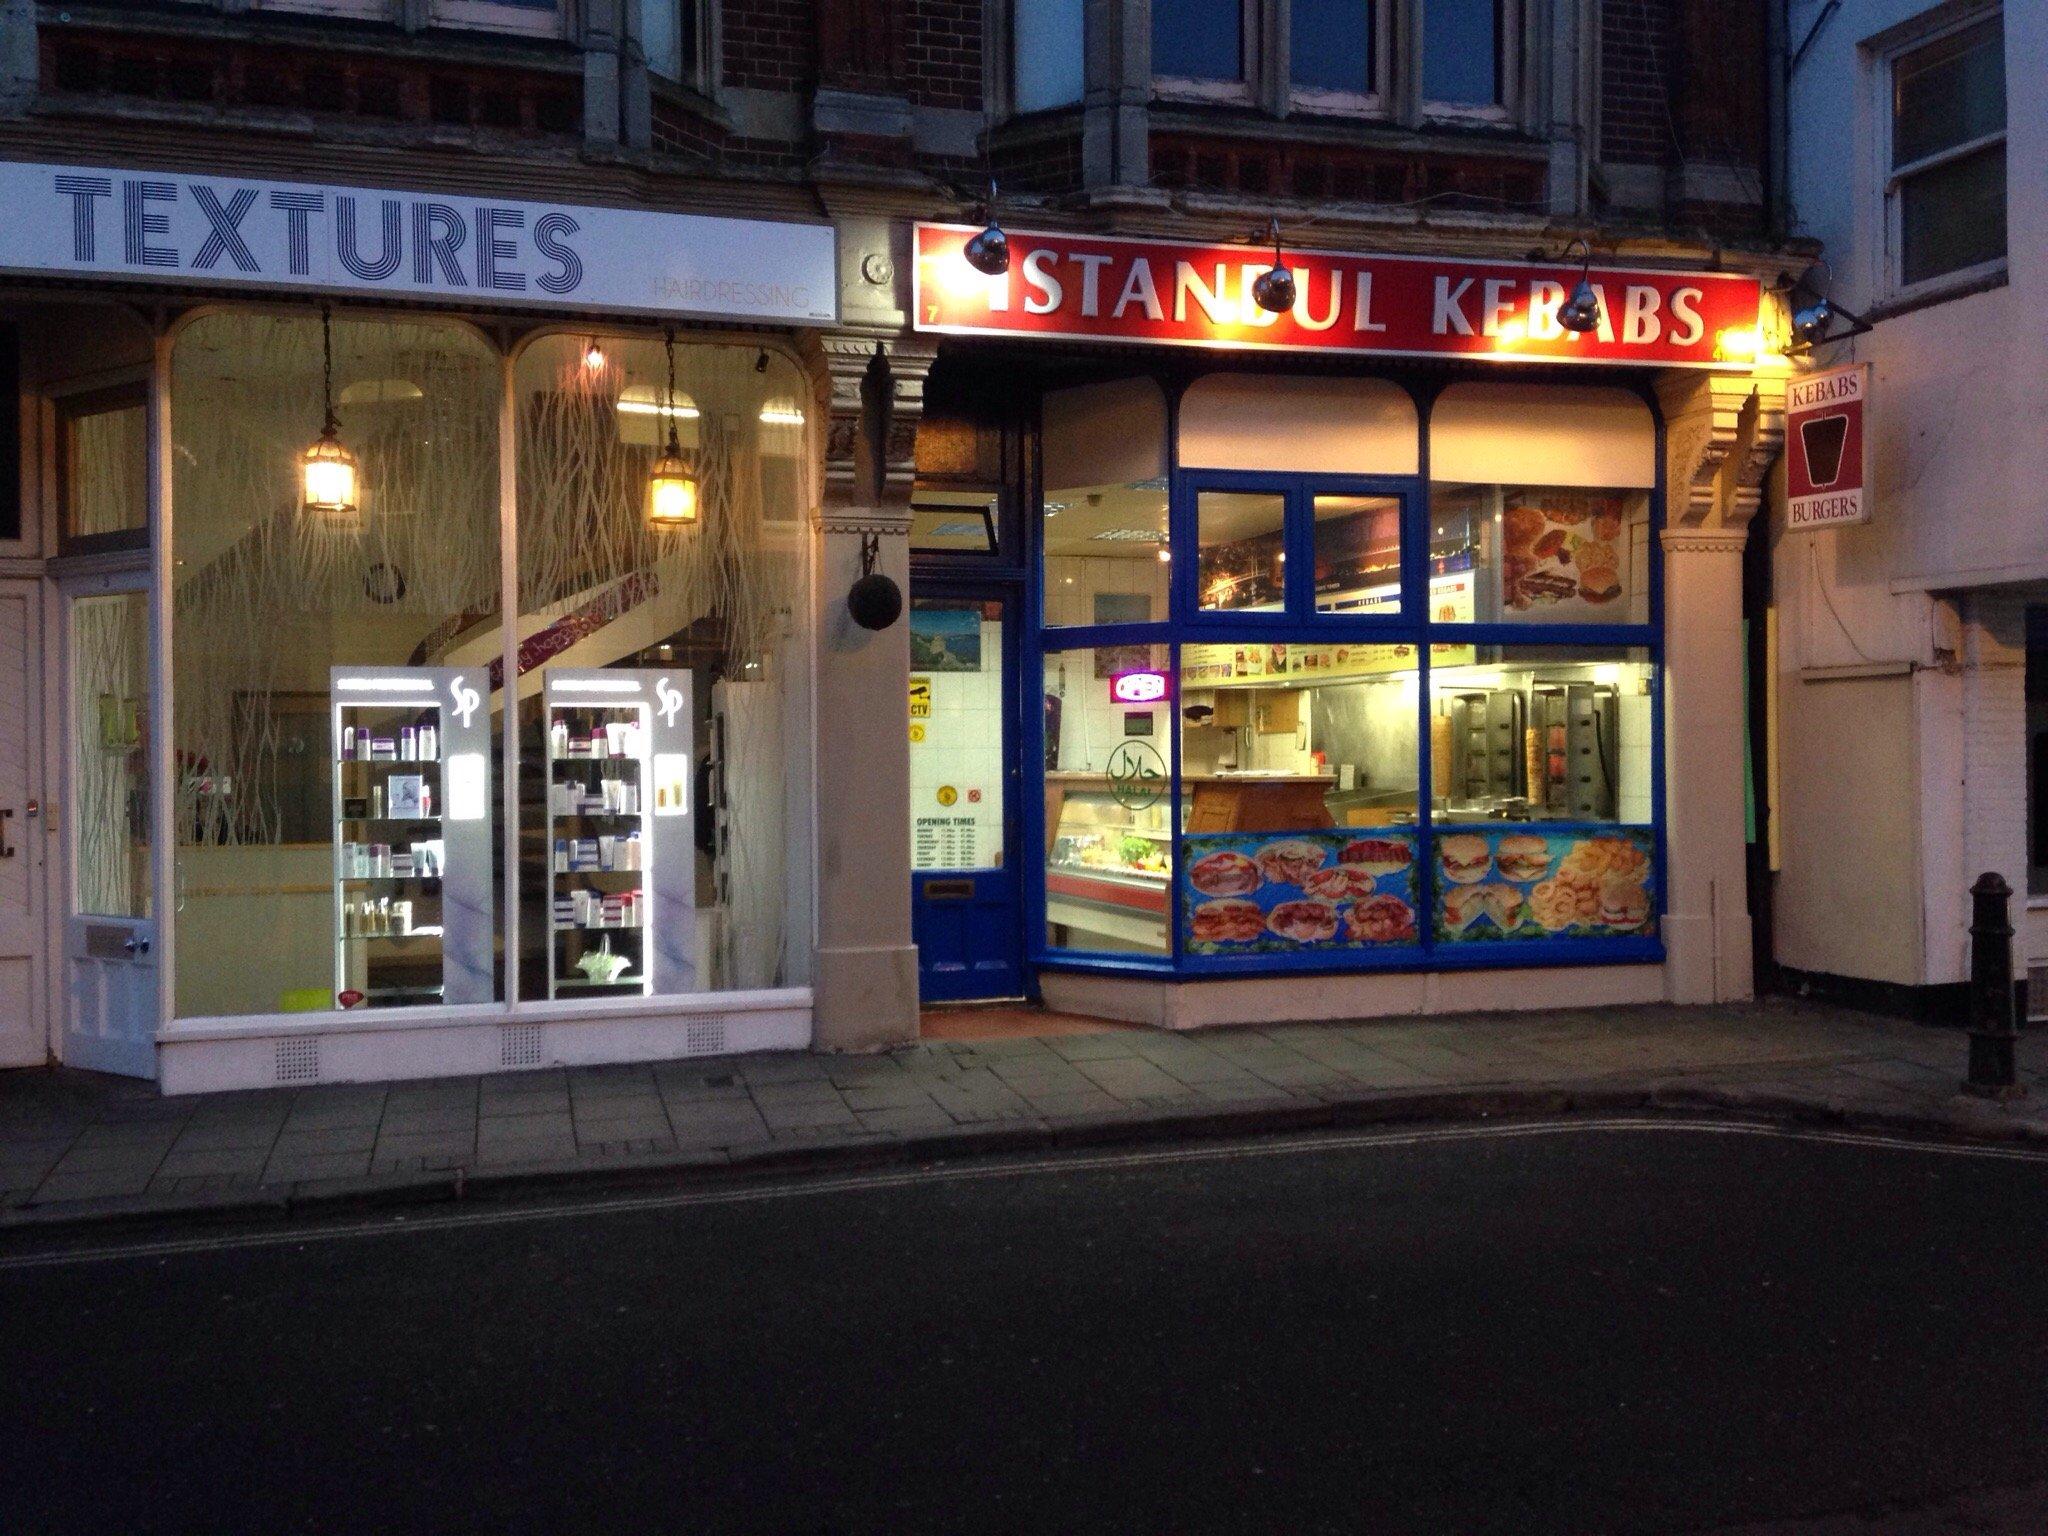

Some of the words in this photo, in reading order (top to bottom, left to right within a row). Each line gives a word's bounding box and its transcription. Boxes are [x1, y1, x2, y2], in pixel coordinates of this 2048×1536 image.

[55, 175, 583, 294] TEXTURES
[653, 275, 810, 309] HAIRDRESSING
[927, 304, 938, 322] 7
[1793, 374, 1858, 407] KEBABS
[1793, 495, 1858, 524] BURGERS
[910, 704, 928, 715] CTV
[916, 817, 951, 827] OPENING
[953, 817, 976, 827] TIMES
